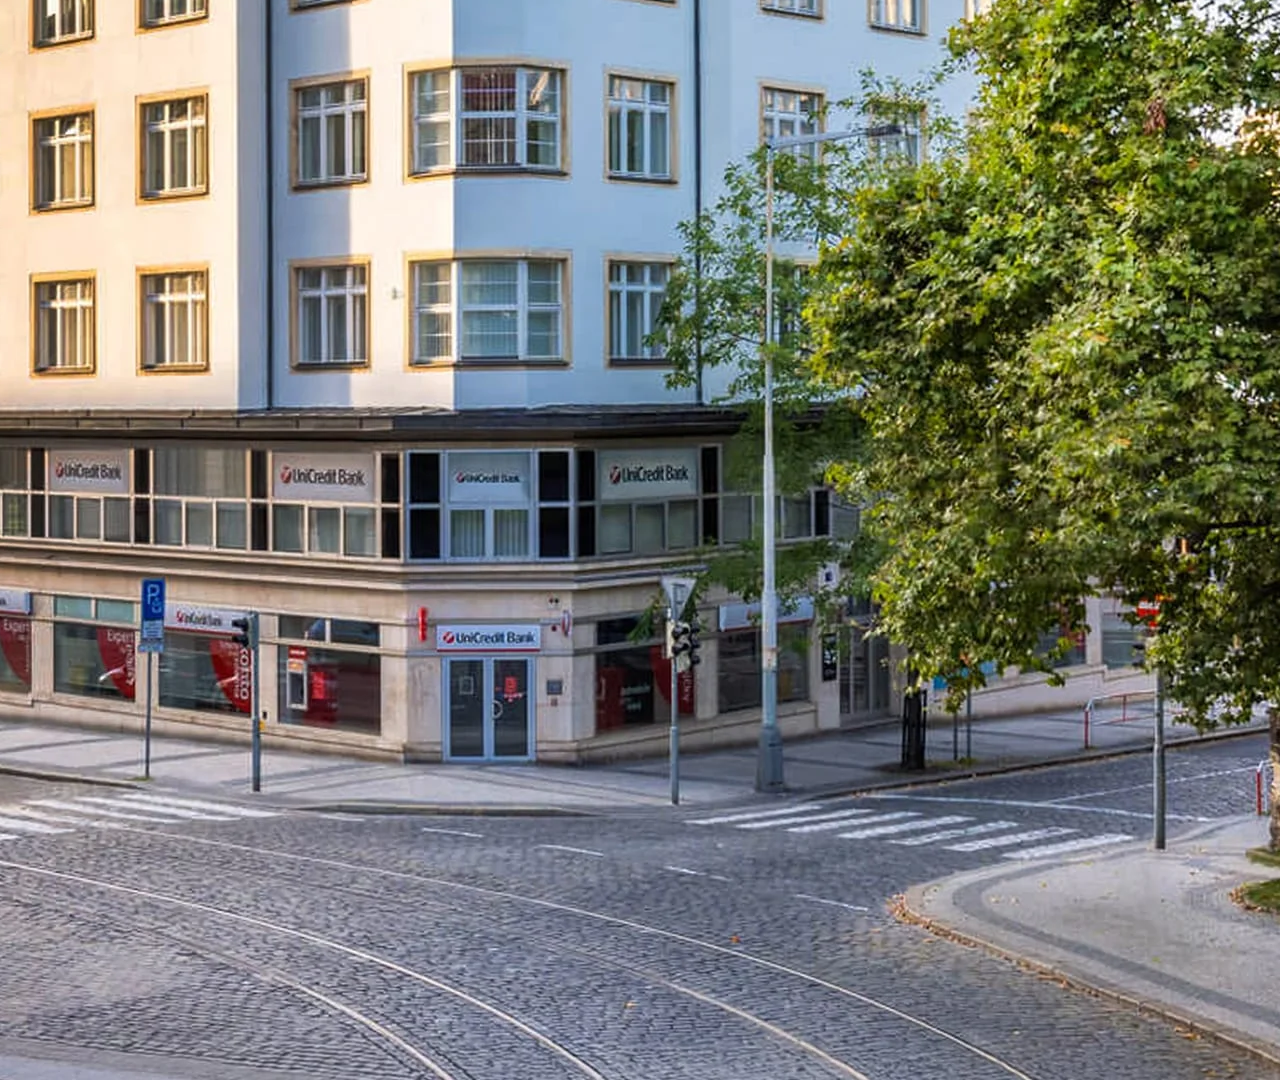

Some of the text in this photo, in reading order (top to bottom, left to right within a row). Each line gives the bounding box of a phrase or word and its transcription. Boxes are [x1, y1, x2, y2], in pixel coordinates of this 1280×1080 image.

[292, 468, 366, 486] UniCredit Bank
[621, 463, 689, 483] UniCredit Bank
[147, 584, 160, 605] P
[456, 631, 535, 644] UniCredit Bank
